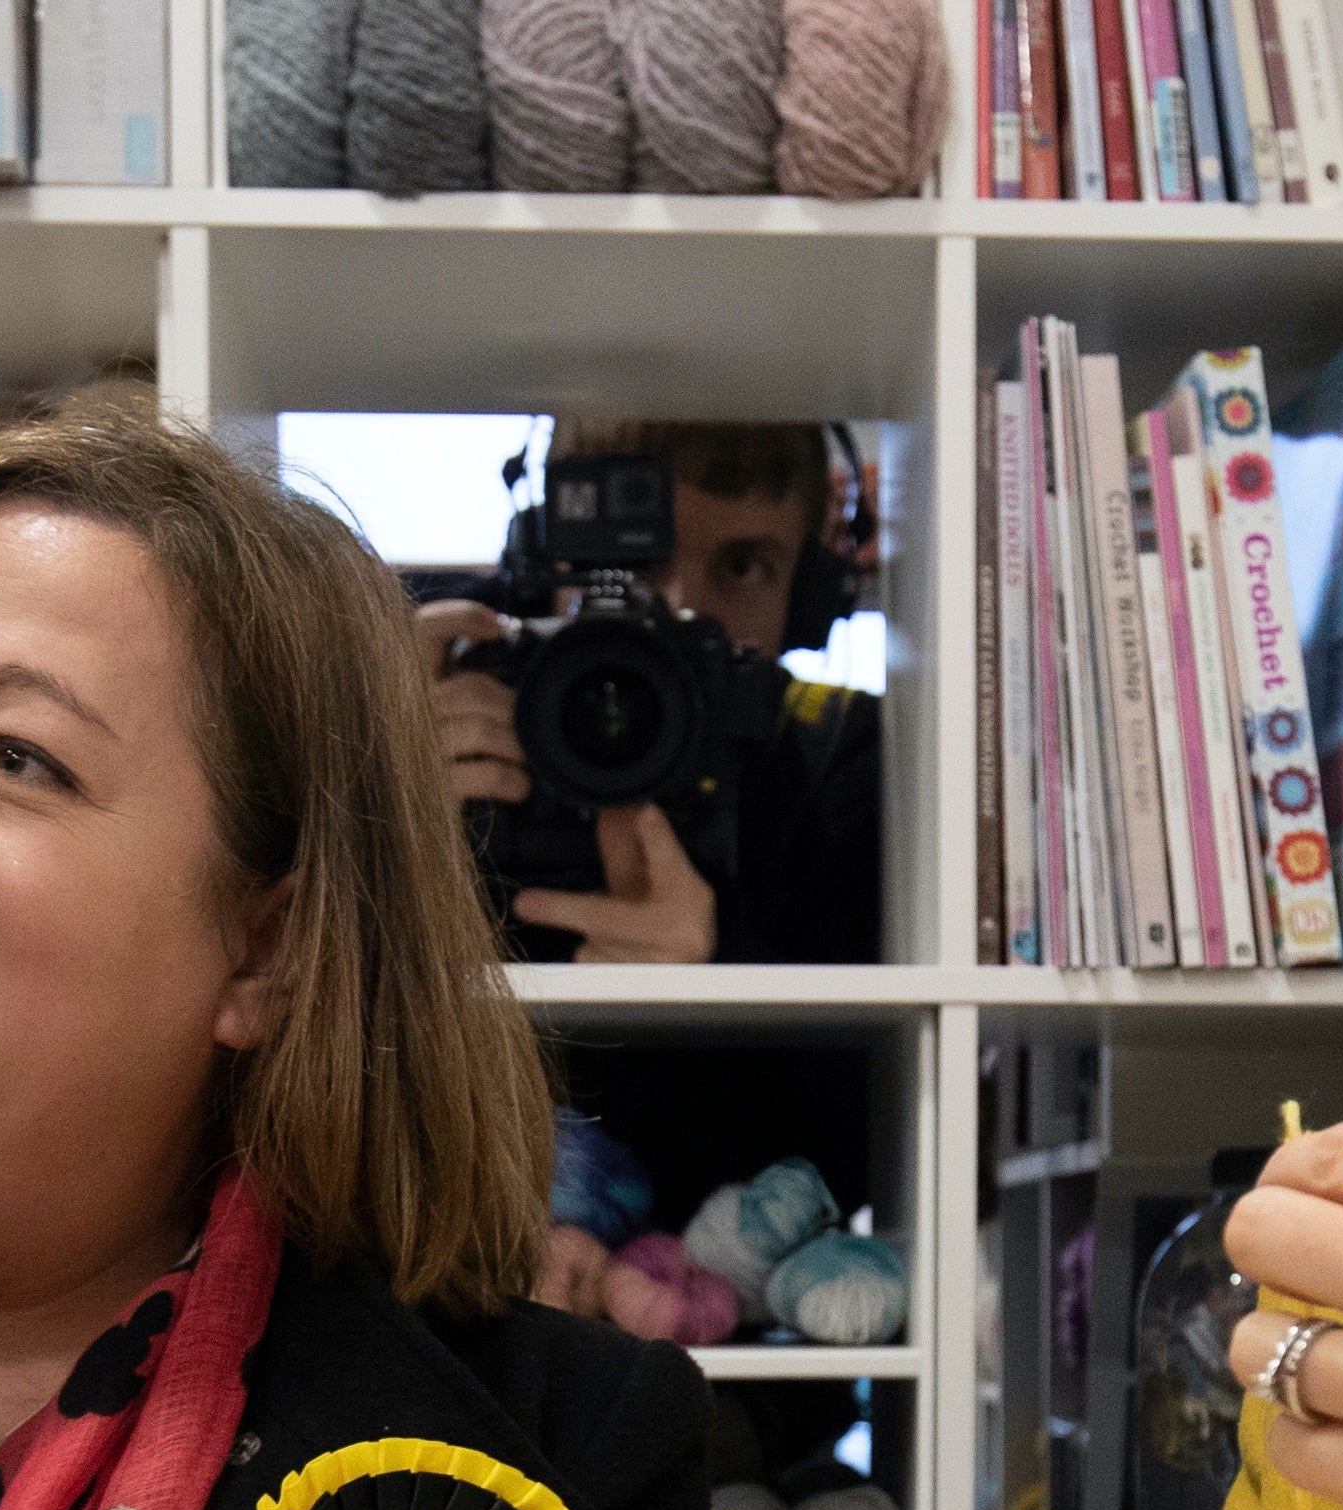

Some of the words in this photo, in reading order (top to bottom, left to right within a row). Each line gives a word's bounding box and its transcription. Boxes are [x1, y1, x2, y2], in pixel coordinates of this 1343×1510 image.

[1106, 489, 1136, 583] Crochet
[1115, 596, 1145, 706] Workshop
[1240, 531, 1290, 693] Crochet
